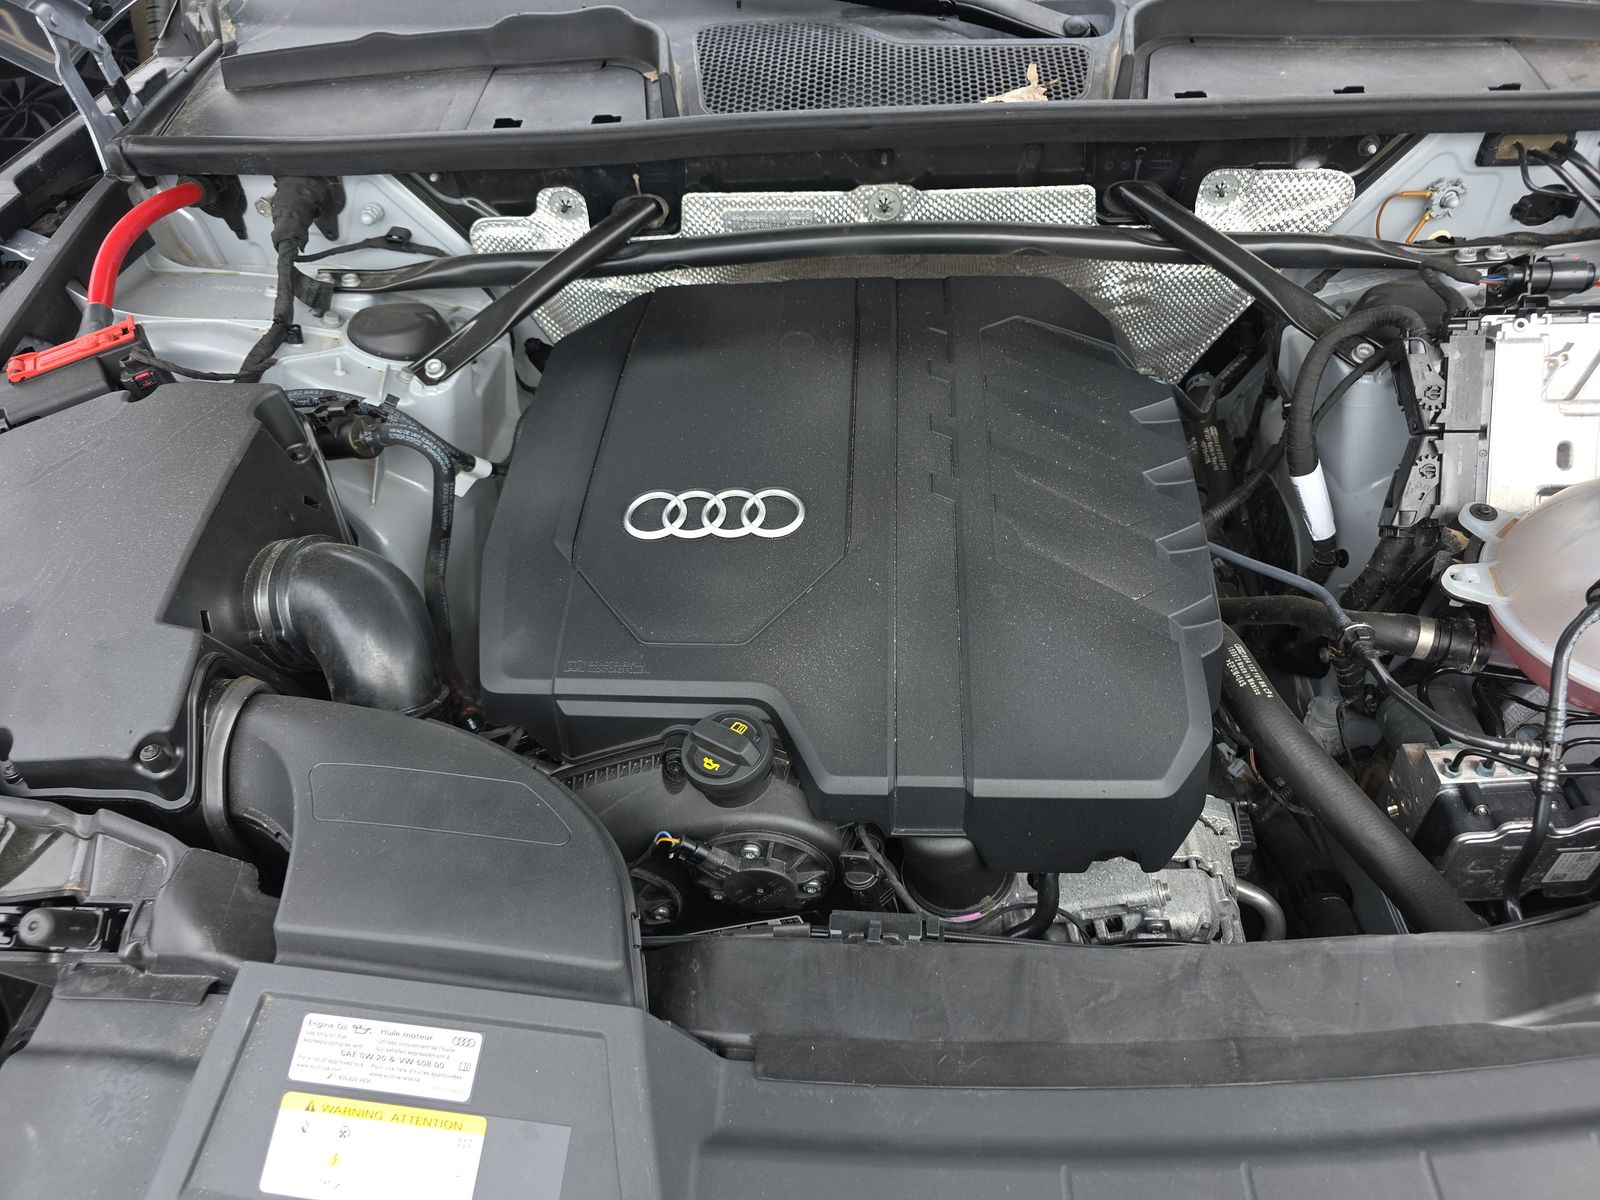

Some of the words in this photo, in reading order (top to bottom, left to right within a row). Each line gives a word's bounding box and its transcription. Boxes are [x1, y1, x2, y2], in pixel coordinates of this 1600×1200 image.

[1247, 678, 1261, 696] Mexico
[308, 1020, 335, 1030] Engine
[380, 1029, 401, 1038] Huile
[402, 1032, 434, 1042] moteur
[340, 1050, 357, 1058] SAE
[359, 1052, 387, 1062] 0W-20
[399, 1057, 415, 1065] VW
[416, 1059, 433, 1068] 508
[433, 1061, 445, 1069] 00
[322, 1104, 383, 1120] WARNING
[390, 1112, 464, 1131] ATTENTION
